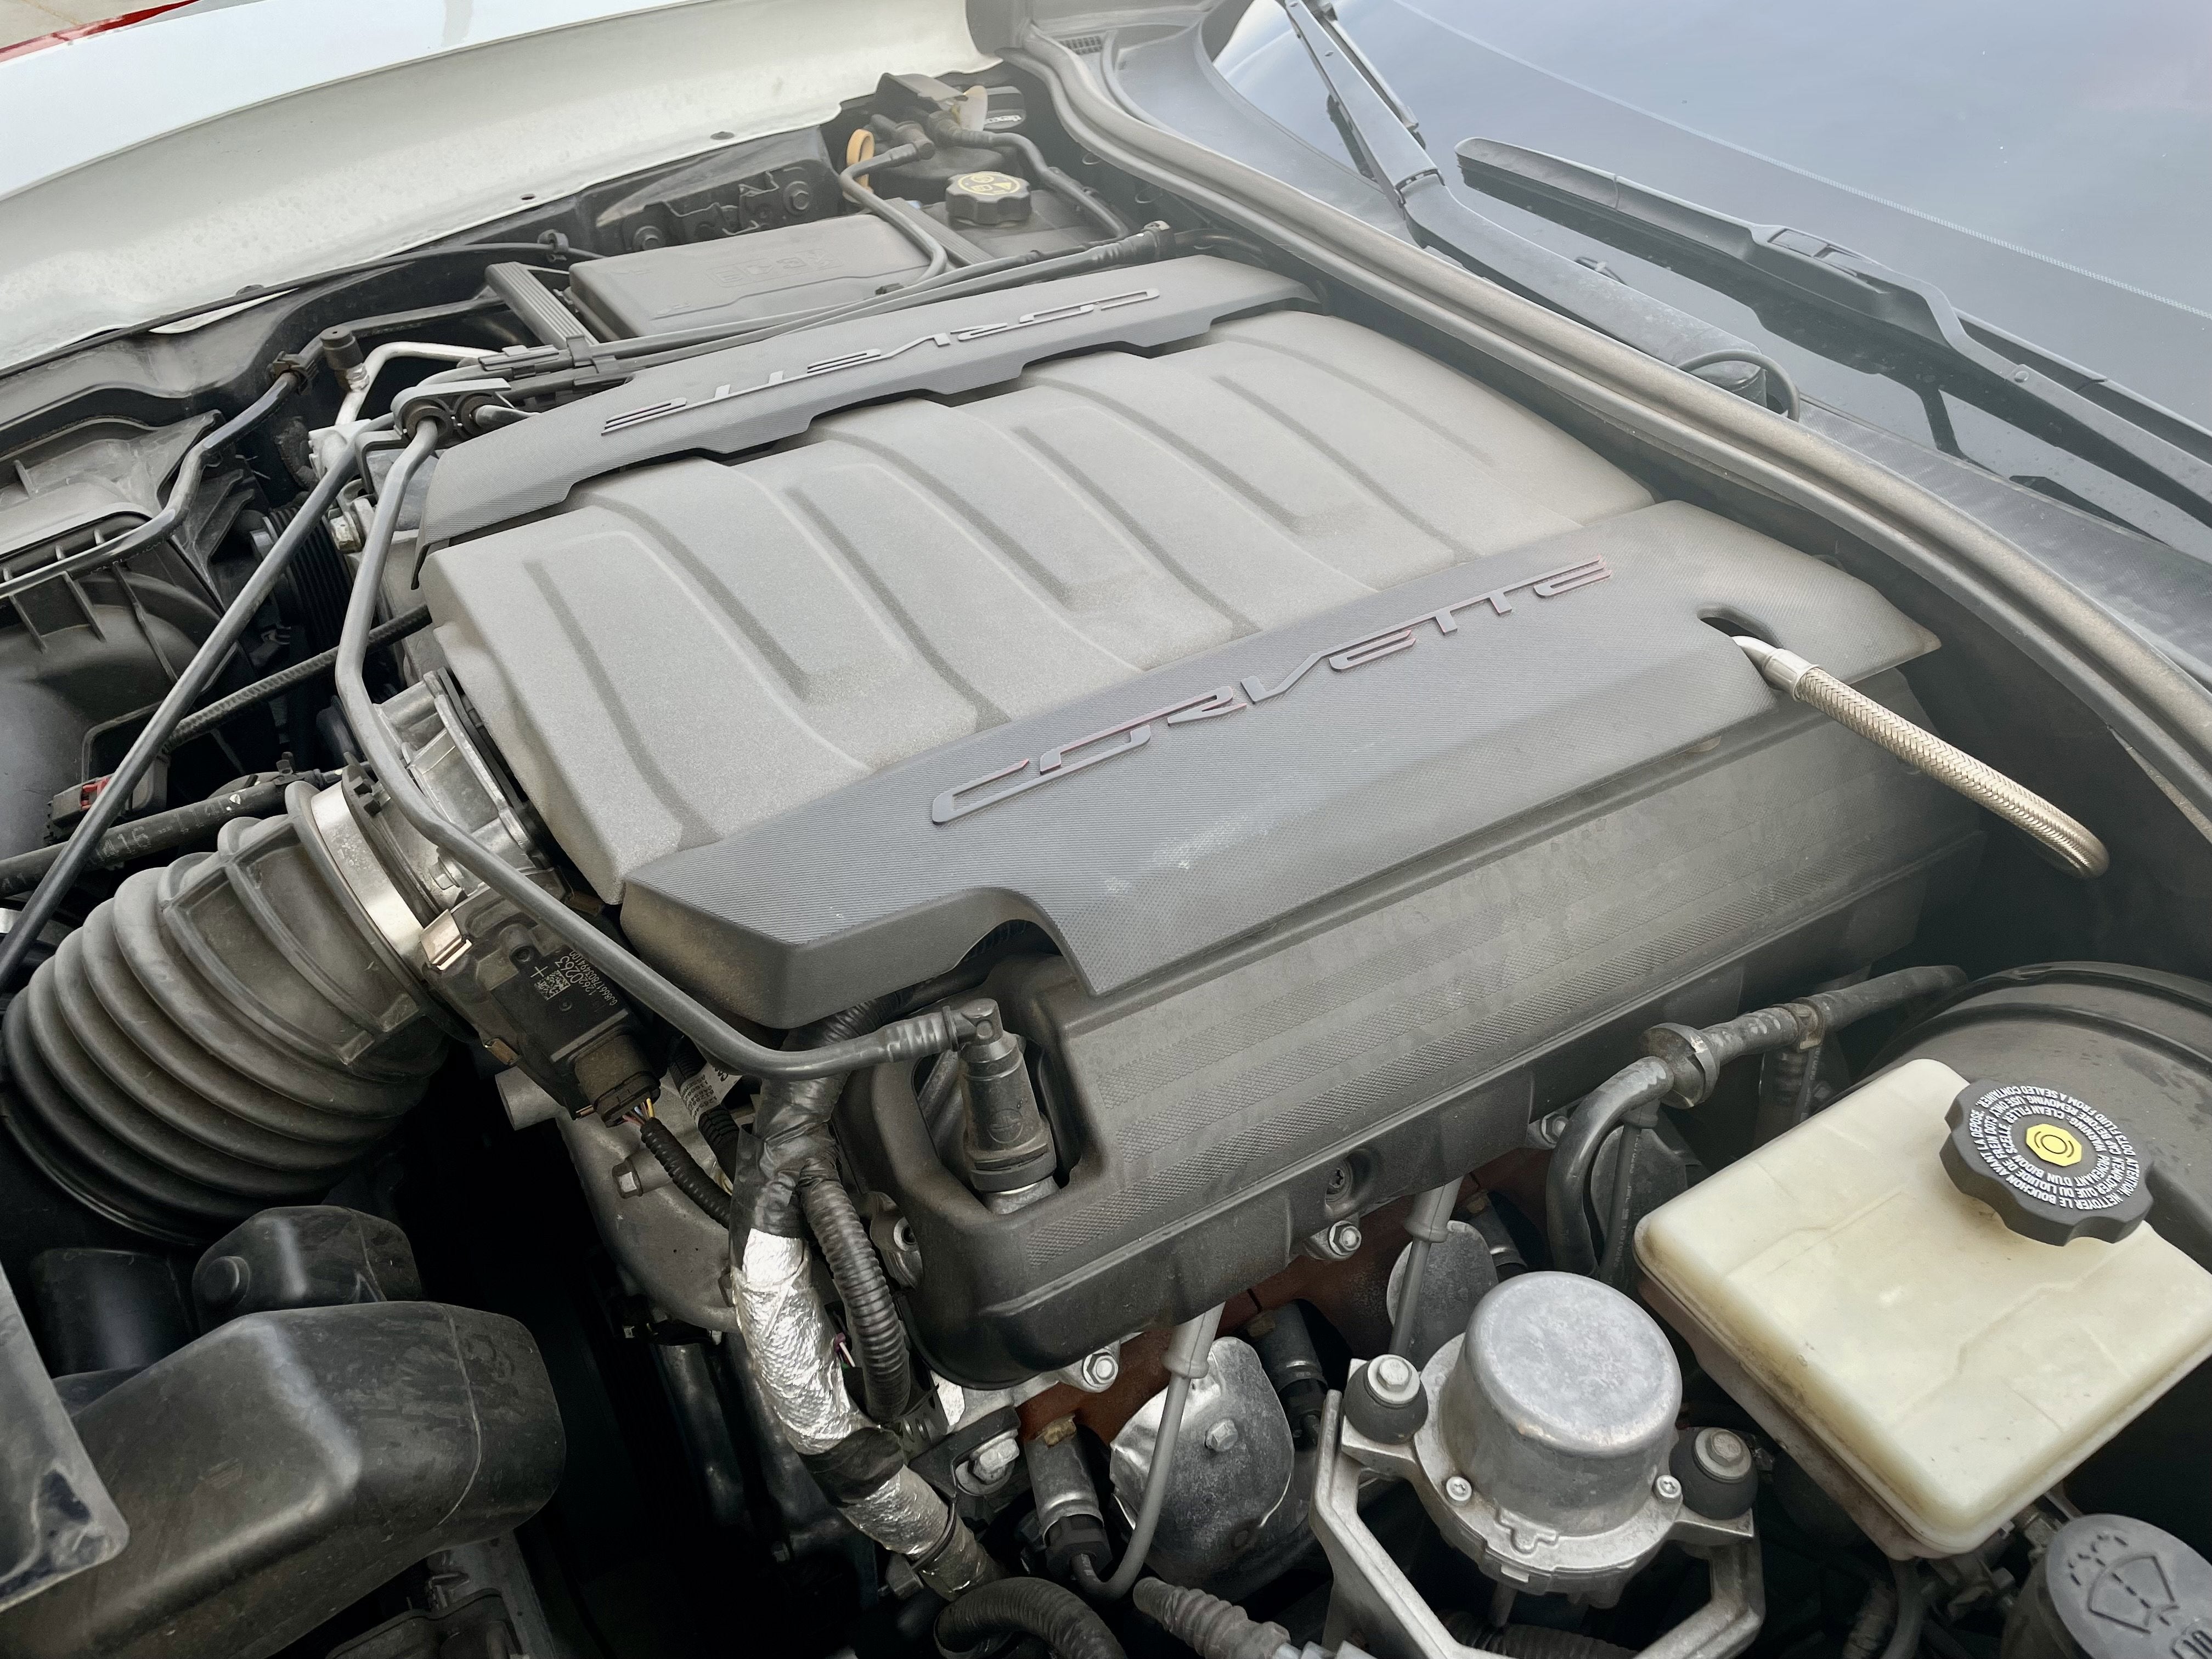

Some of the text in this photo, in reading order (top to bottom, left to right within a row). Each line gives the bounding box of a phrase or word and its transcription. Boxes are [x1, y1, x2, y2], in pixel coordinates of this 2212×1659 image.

[601, 287, 1160, 437] CORVETTE
[932, 554, 1612, 825] CORVETTE
[2020, 1085, 2058, 1098] SEALED
[2060, 1093, 2067, 1101] A
[1989, 1101, 2010, 1118] ONLY
[2005, 1096, 2026, 1107] USE
[2067, 1097, 2097, 1116] FROM
[1984, 1116, 1997, 1135] DOT3
[2002, 1105, 2107, 1152] WARNING: CLEAN FILLER
[2077, 1111, 2112, 1139] BEFORE
[2095, 1114, 2122, 1135] FLUID
[1974, 1139, 1989, 1150] LA
[1986, 1136, 2008, 1159] FREIN
[2105, 1140, 2121, 1154] CAP
[2115, 1135, 2136, 1155] DOT3
[1980, 1152, 2011, 1176] AVANT
[2002, 1159, 2019, 1171] DE
[2012, 1154, 2044, 1178] BIDON
[2074, 1154, 2110, 1186] PROVENANT
[2006, 1175, 2056, 1204] BOUCHON
[2016, 1169, 2057, 1194] LIQUIDE
[2059, 1186, 2075, 1198] DU
[2074, 1193, 2123, 1210] NETTOYER
[2075, 1187, 2098, 1198] QUE
[2059, 1197, 2073, 1209] LE
